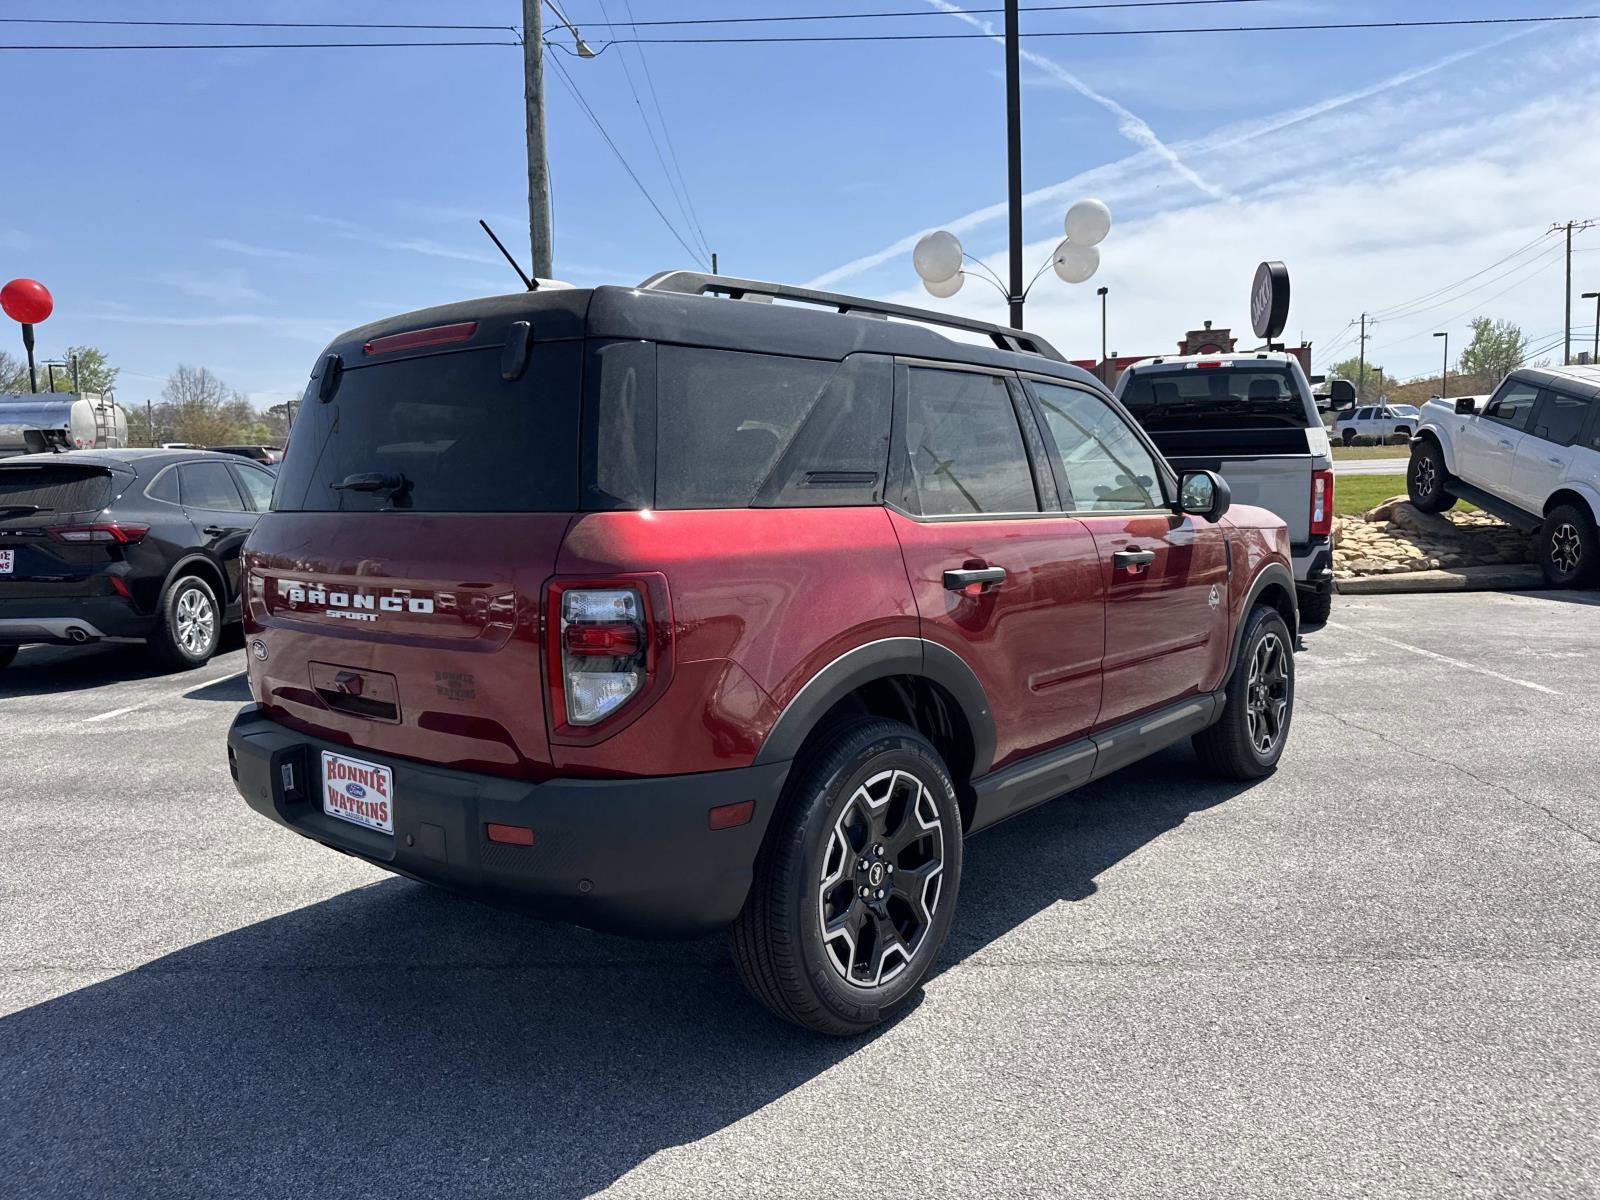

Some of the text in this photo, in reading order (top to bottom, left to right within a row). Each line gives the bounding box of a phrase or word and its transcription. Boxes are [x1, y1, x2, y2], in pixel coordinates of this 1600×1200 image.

[290, 589, 434, 613] BRONCO
[326, 610, 379, 621] SPORT
[327, 760, 387, 797] RONNIE
[348, 784, 364, 796] Ford
[327, 784, 388, 822] WATKINS
